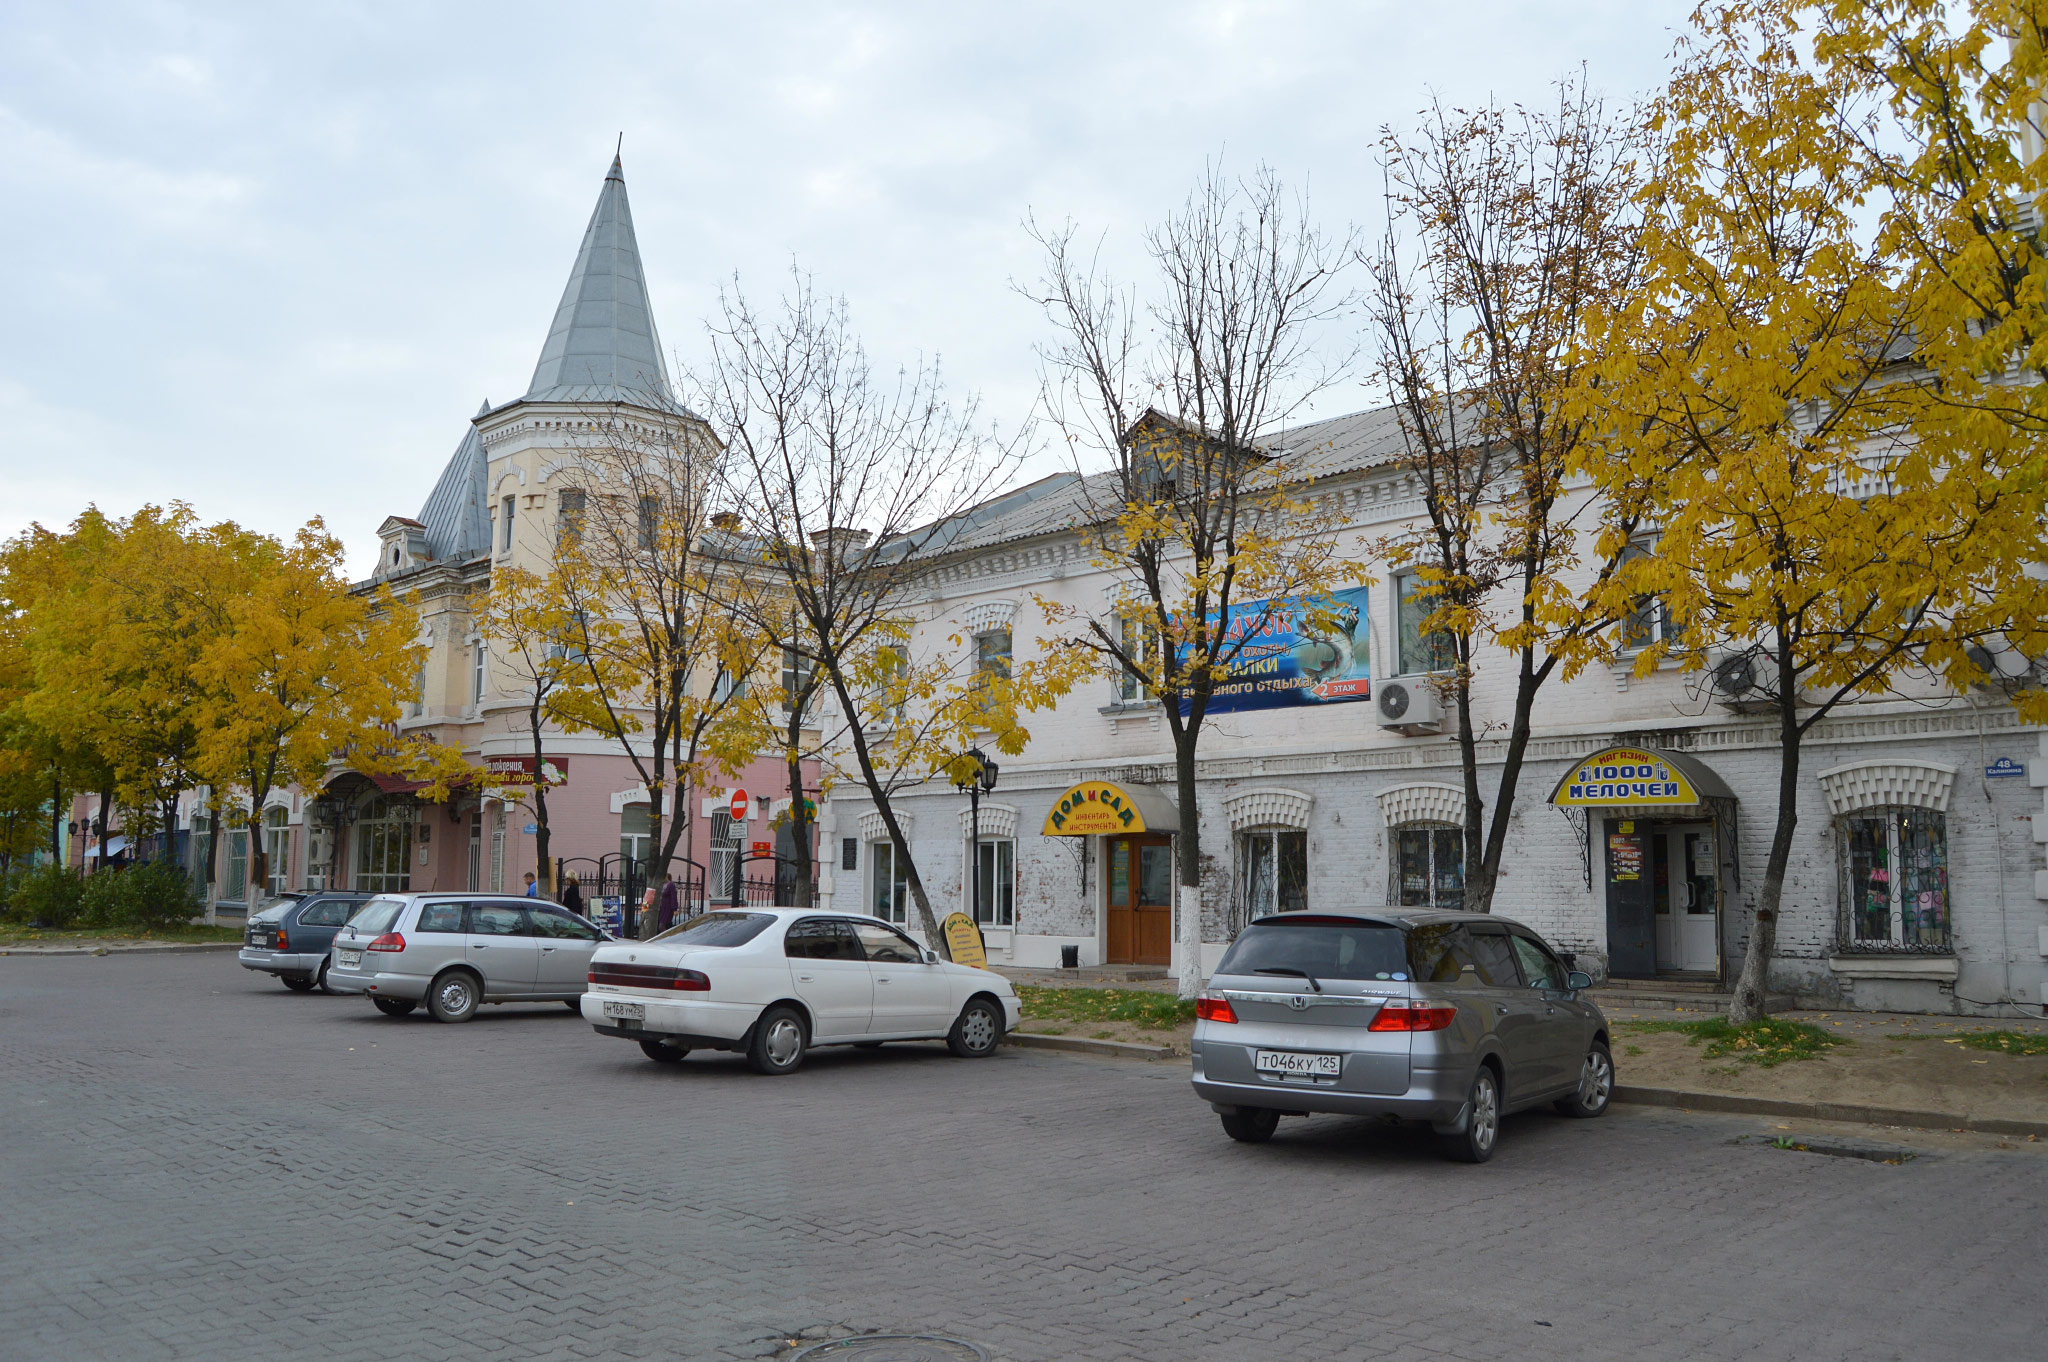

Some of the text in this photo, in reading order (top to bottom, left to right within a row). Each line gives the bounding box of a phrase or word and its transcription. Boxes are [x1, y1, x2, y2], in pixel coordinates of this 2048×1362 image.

[1242, 643, 1291, 660] охоты,
[1214, 657, 1279, 677] БАЛКИ
[1181, 677, 1312, 699] аквного отдыха
[1319, 683, 1356, 697] 2 ЭТАЖ
[1598, 751, 1649, 765] МАГАЗИН
[1997, 760, 2011, 768] 48
[1594, 765, 1653, 780] 1000
[1569, 782, 1679, 799] МЕЛОЧЕЙ
[1051, 789, 1085, 830] ДОМ
[1100, 789, 1136, 828] САД
[1075, 812, 1110, 821] ИНВЕНТАРЬ
[1069, 822, 1117, 831] ИНСТРУМЕНТЫ
[1262, 1054, 1336, 1071] Т046КУ 125
